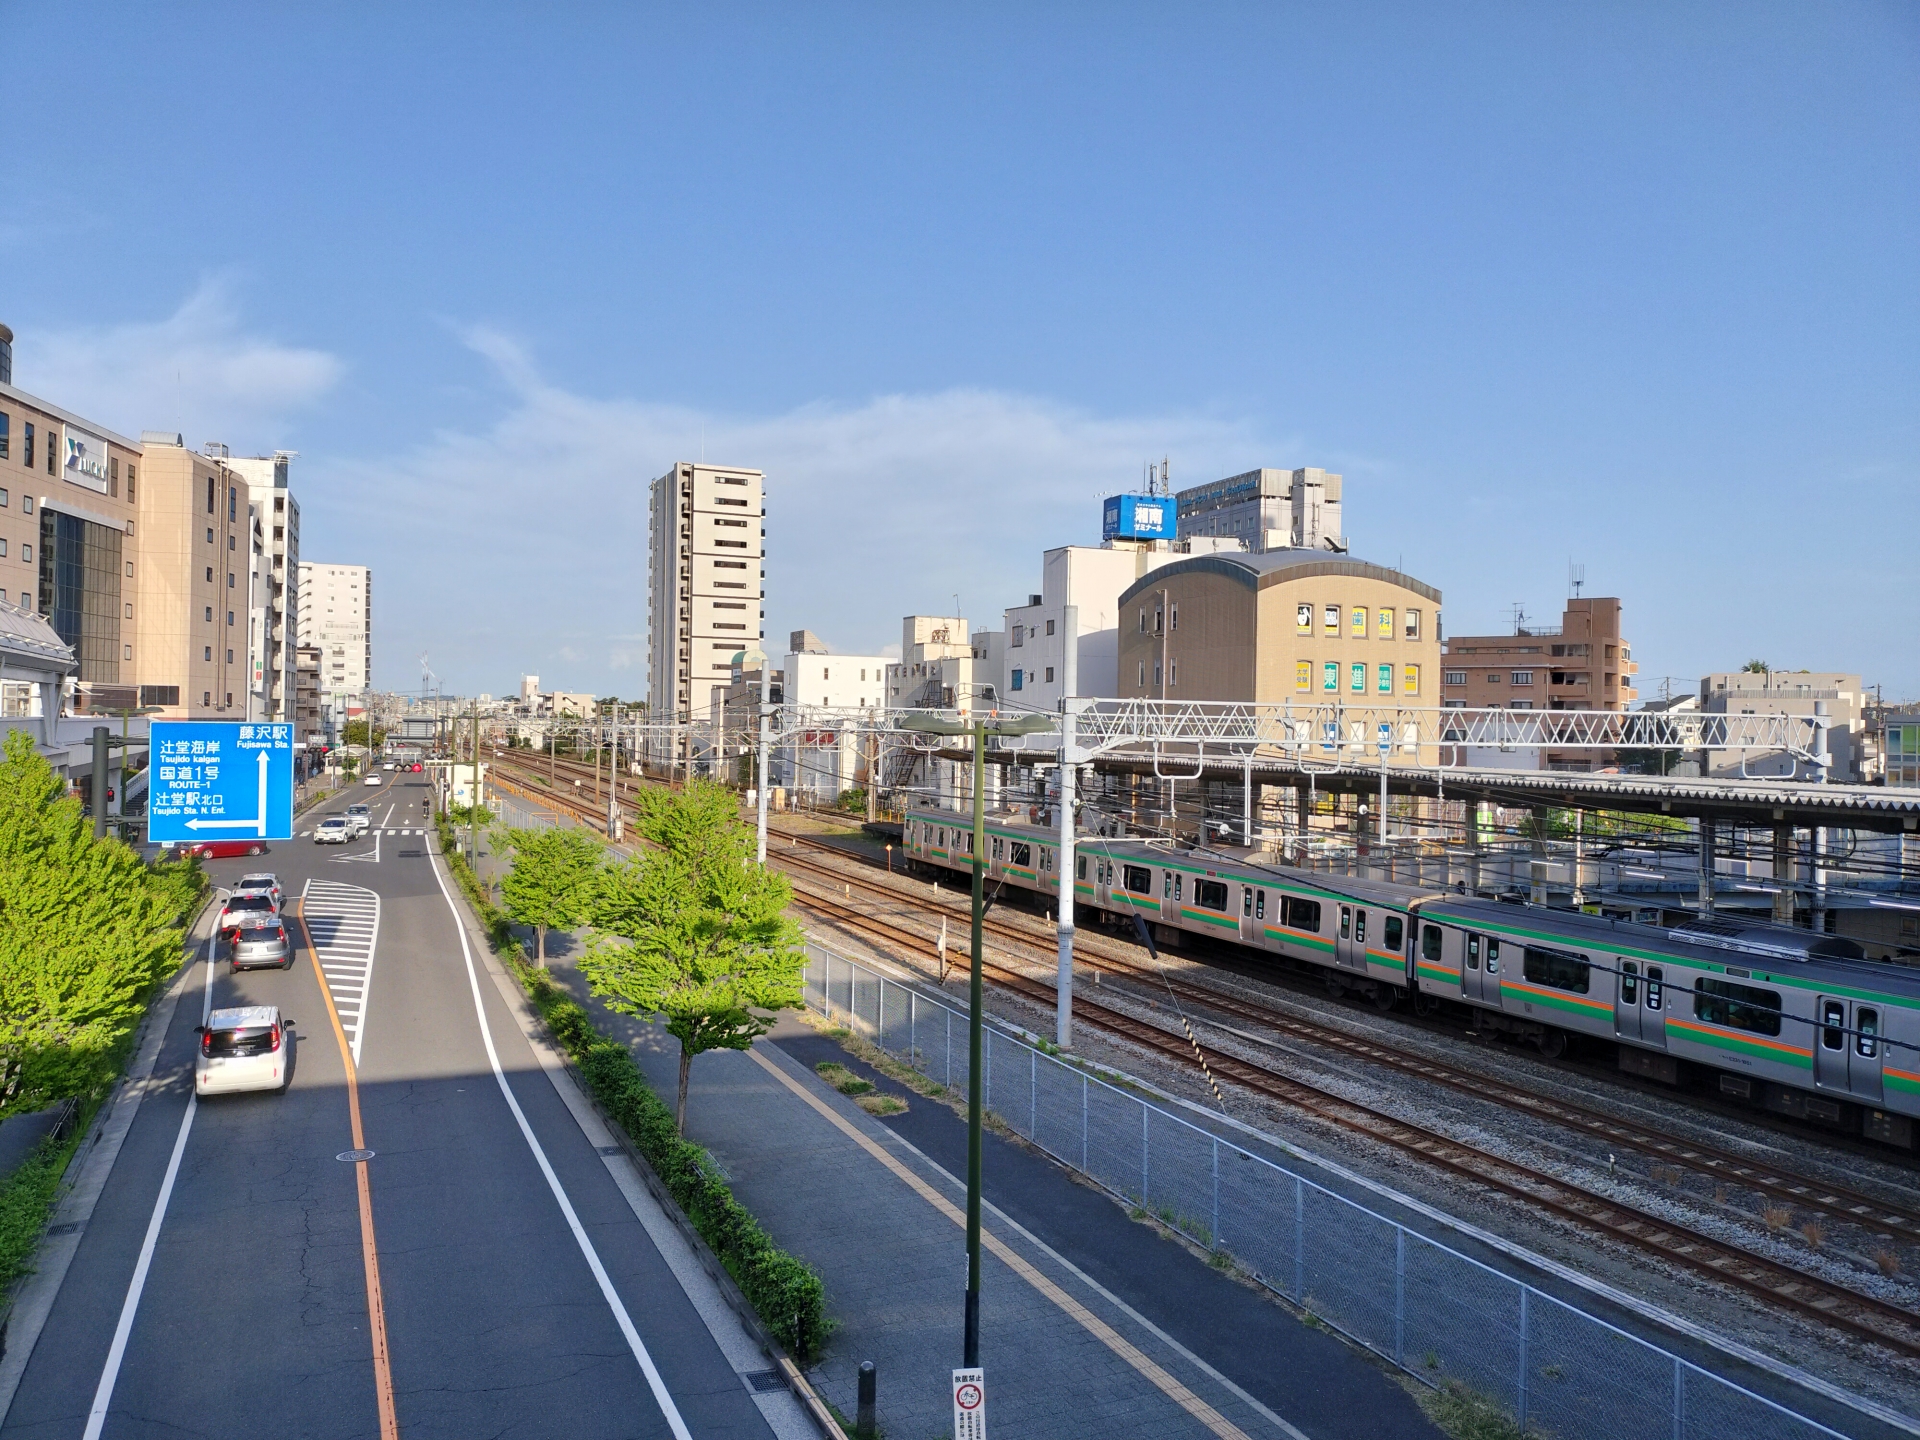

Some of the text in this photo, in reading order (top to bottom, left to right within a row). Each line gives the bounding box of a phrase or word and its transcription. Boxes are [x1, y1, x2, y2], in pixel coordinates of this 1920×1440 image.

[1135, 506, 1163, 524] 湘南
[1134, 524, 1163, 532] ゼミナール
[239, 726, 288, 740] 藤沢駅
[160, 740, 220, 754] 辻堂海岸
[236, 740, 271, 749] Fujisawa
[274, 740, 289, 749] Sta.
[160, 755, 220, 764] Tsujido kaigan
[160, 766, 220, 780] 国道1号
[169, 781, 211, 789] ROUTE-1
[155, 792, 223, 806] 辻堂駅北口
[152, 807, 181, 816] Tsujido
[184, 807, 198, 815] Sta.
[955, 1374, 982, 1382] 放置禁止
